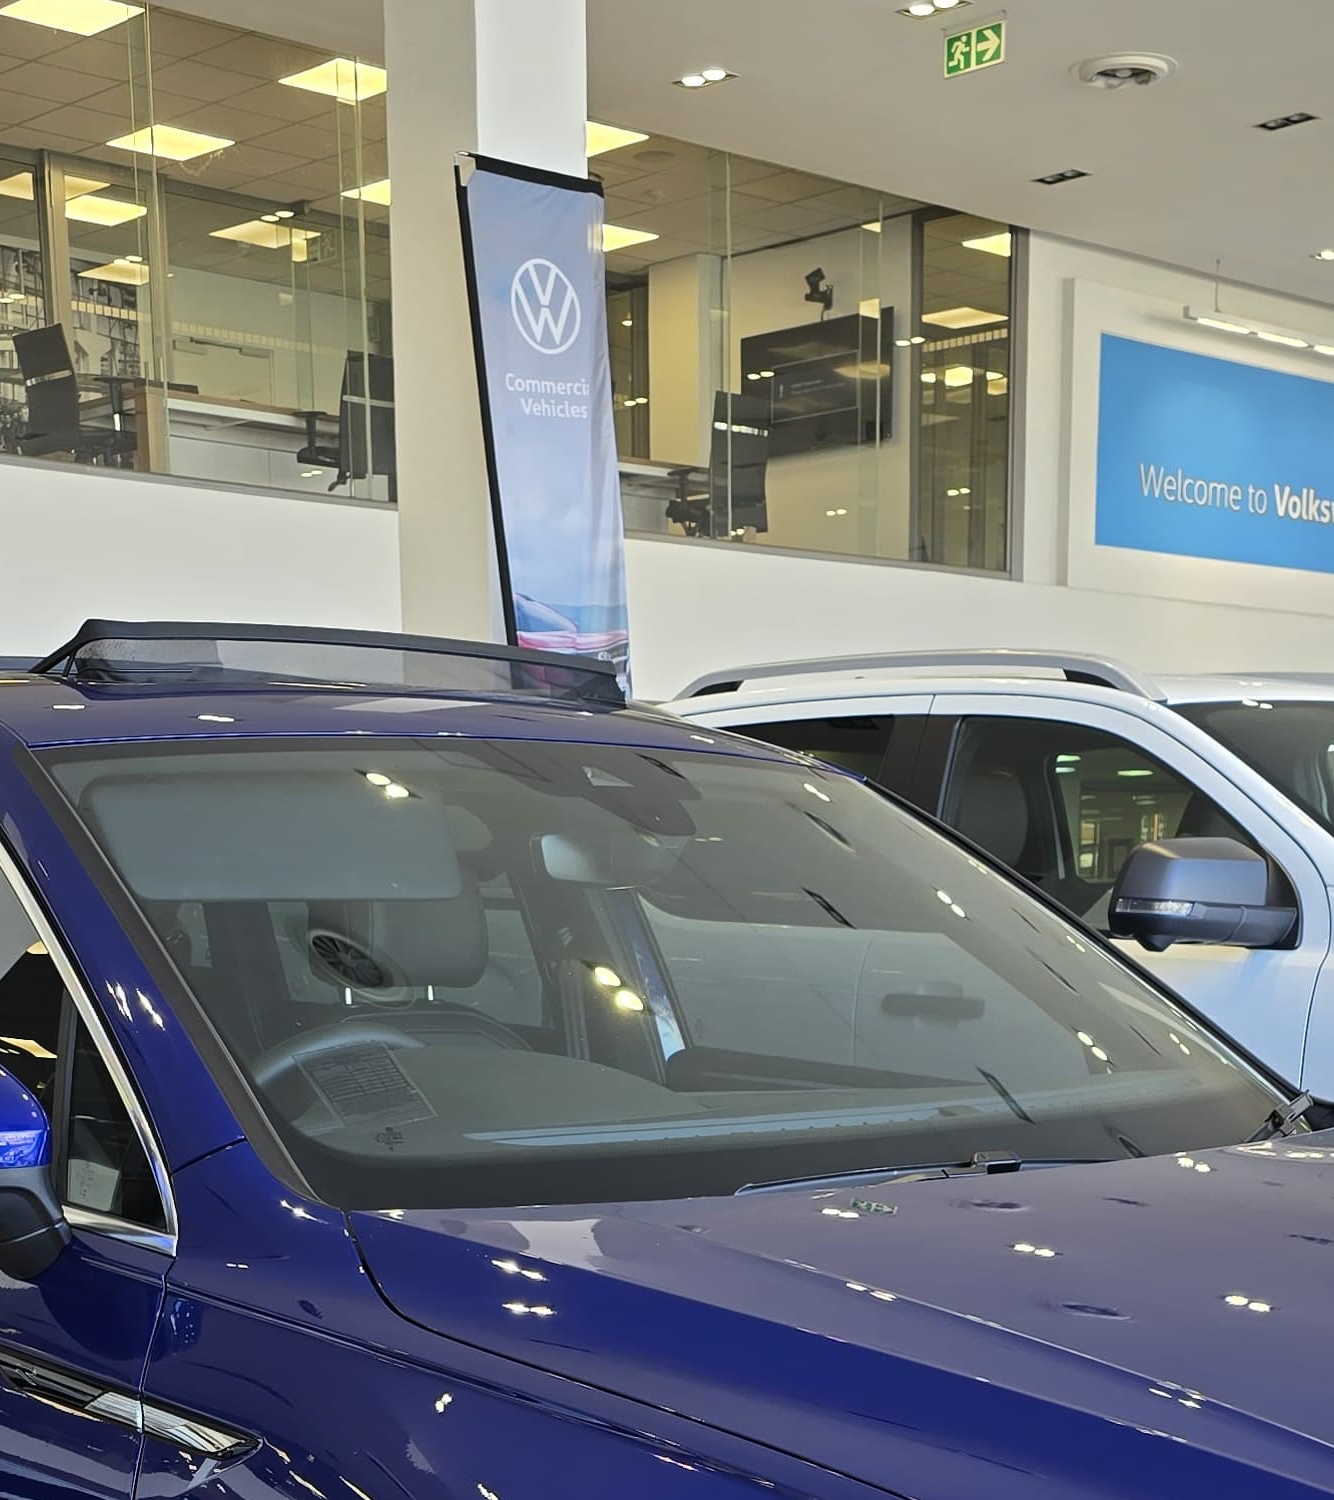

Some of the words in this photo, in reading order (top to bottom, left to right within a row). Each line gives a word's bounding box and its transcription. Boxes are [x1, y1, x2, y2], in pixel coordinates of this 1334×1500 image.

[505, 372, 590, 397] Commerci
[520, 398, 588, 419] Vehicles
[1139, 463, 1242, 511] Welcome
[1248, 484, 1267, 515] to
